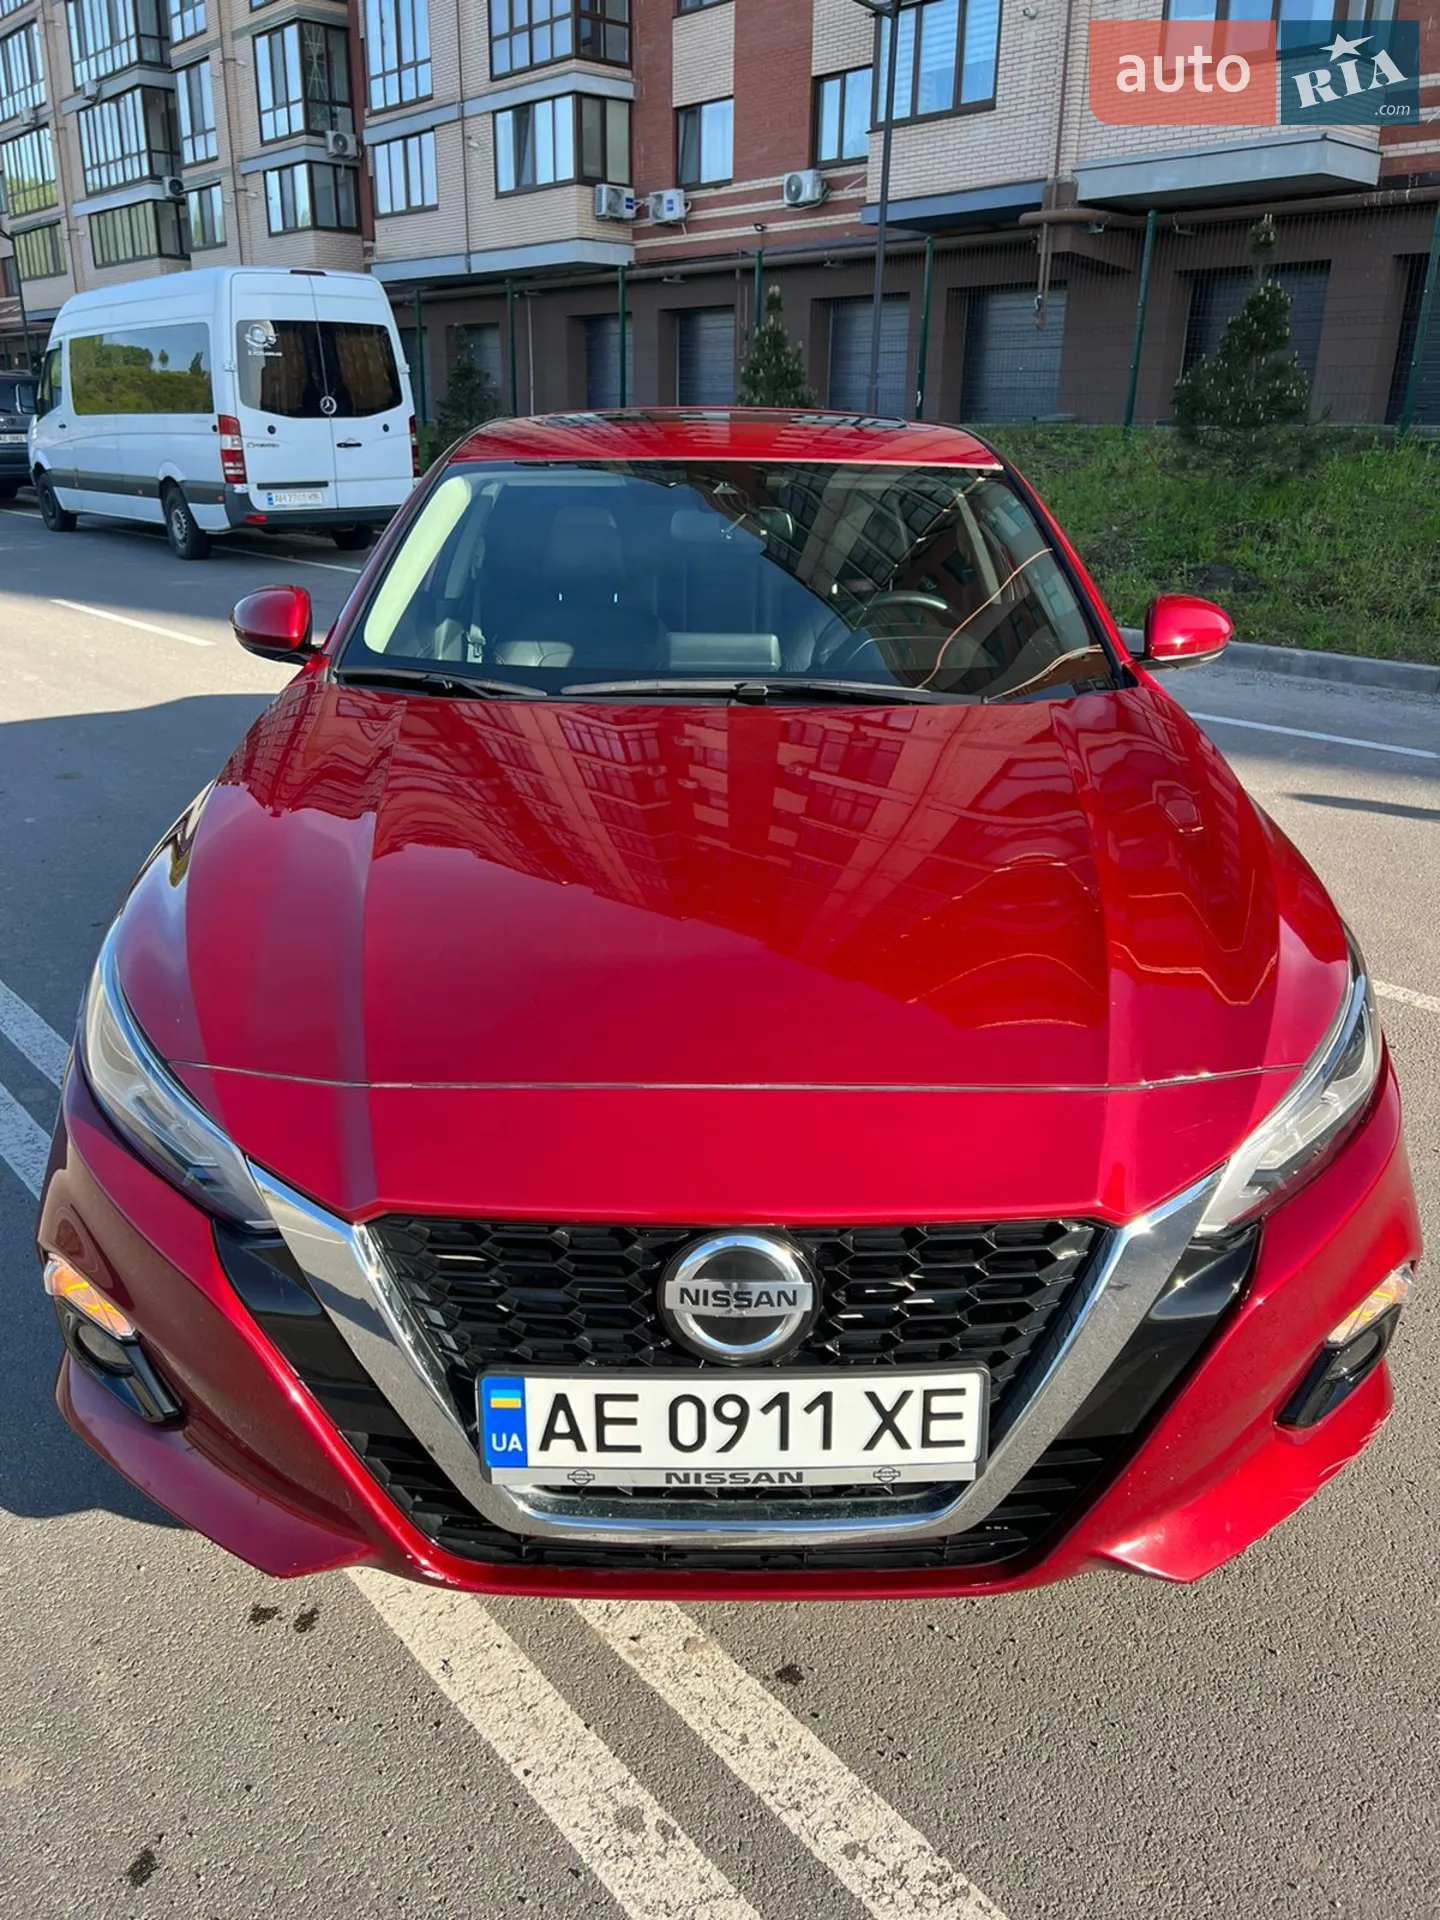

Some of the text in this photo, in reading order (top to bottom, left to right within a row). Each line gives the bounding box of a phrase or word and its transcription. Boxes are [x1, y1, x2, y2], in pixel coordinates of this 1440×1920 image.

[679, 1287, 798, 1309] NISSAN
[538, 1387, 967, 1454] AE 0911 XE
[492, 1434, 523, 1453] UA
[664, 1471, 805, 1485] NISSAN
